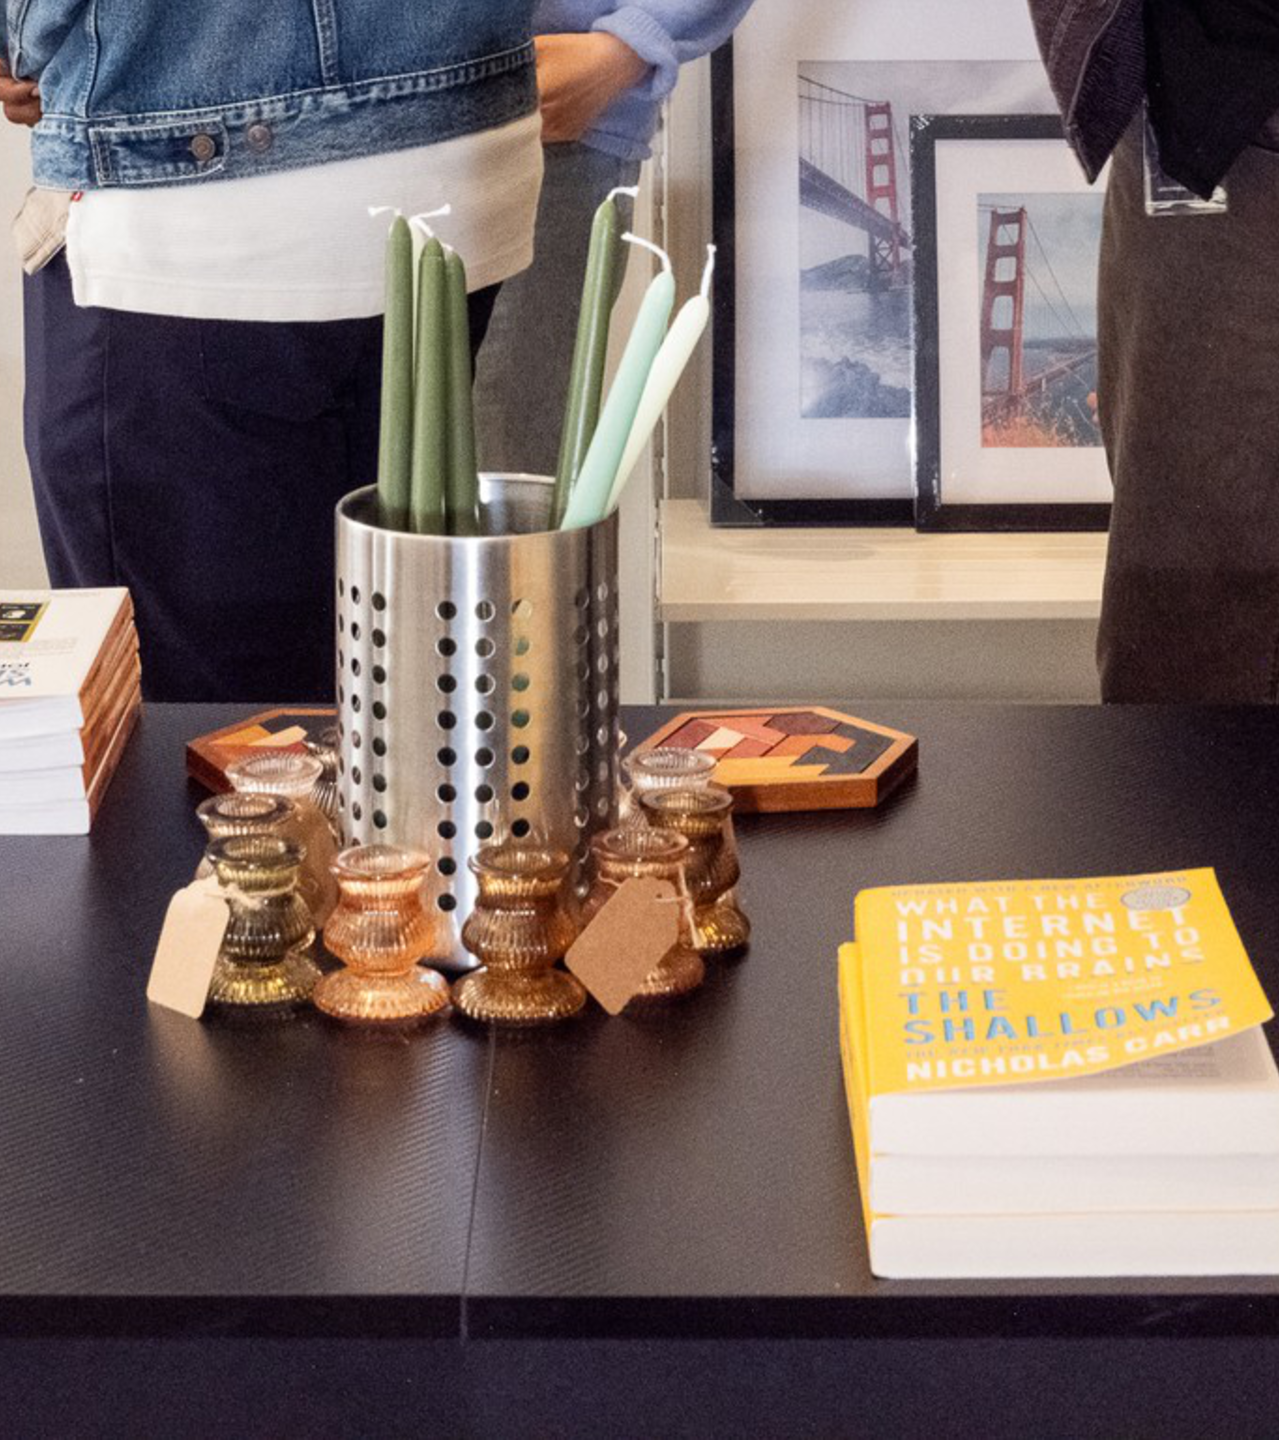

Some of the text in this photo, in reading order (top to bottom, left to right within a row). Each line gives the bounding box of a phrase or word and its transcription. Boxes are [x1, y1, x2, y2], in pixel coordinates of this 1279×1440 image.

[894, 896, 1011, 916] WHAT
[1032, 893, 1108, 912] THE
[896, 908, 1190, 943] INTERNET
[899, 927, 1200, 965] IS DOING TO
[899, 947, 1207, 987] OUR BRAINS
[899, 989, 1008, 1015] THE
[903, 988, 1222, 1046] SHALLOWS
[906, 1045, 1110, 1082] NICHOLAS
[1124, 1015, 1230, 1054] CARR
